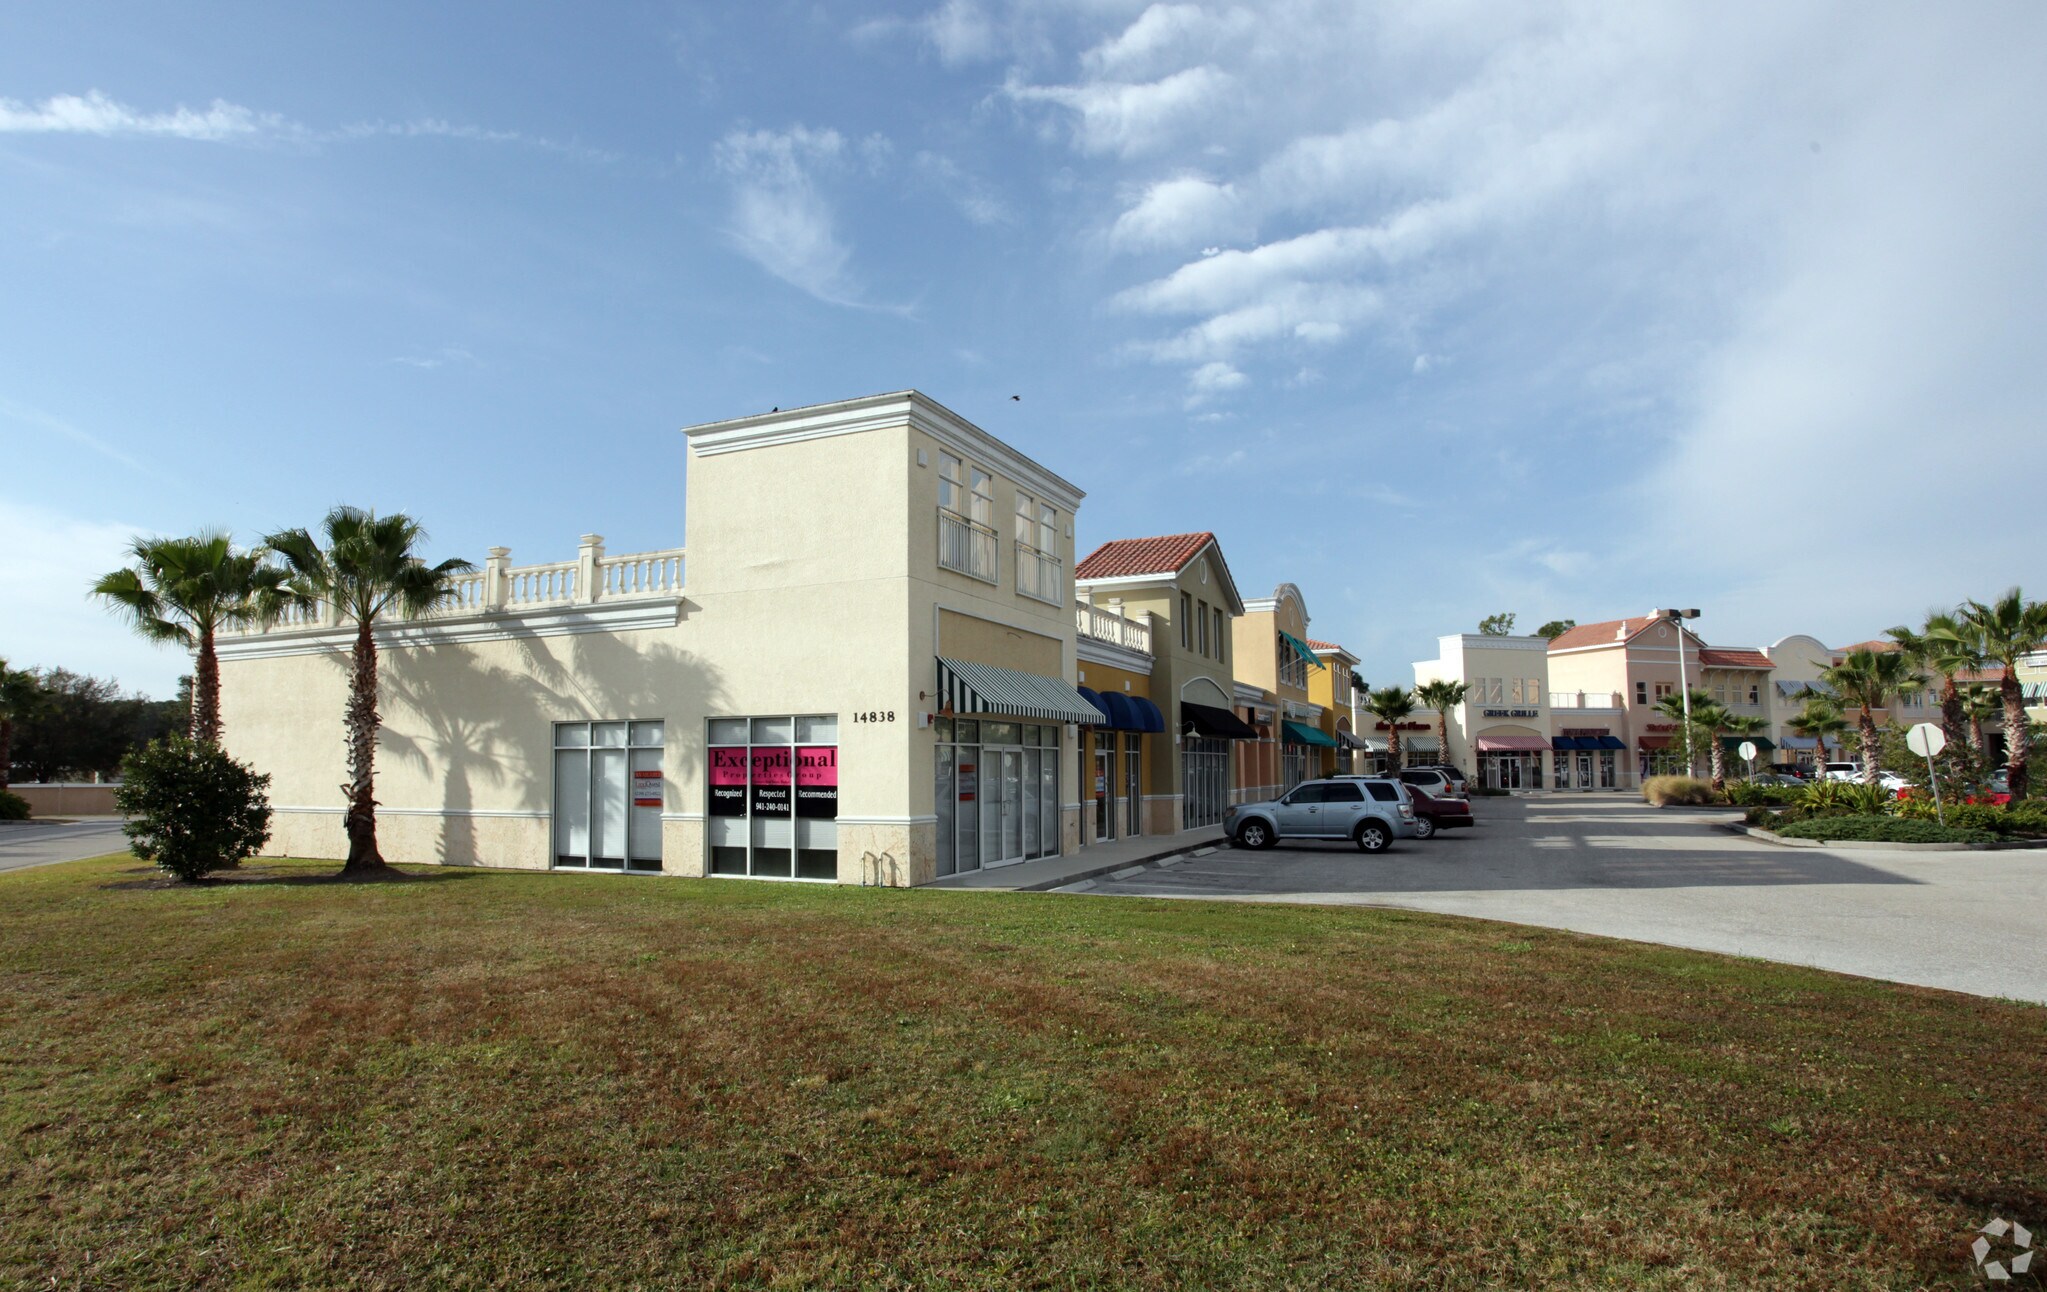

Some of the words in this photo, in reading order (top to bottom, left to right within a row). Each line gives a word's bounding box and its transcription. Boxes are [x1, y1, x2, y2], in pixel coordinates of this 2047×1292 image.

[853, 710, 895, 723] 14838
[1483, 709, 1509, 717] GREEK
[1510, 709, 1539, 717] GRILLE
[713, 749, 836, 772] Exceptional
[722, 770, 783, 779] Properties
[787, 771, 822, 779] Group
[714, 789, 742, 799] Recognized
[759, 789, 785, 799] Respected
[798, 789, 837, 799] Recommended
[755, 802, 790, 811] 941-240-0141
